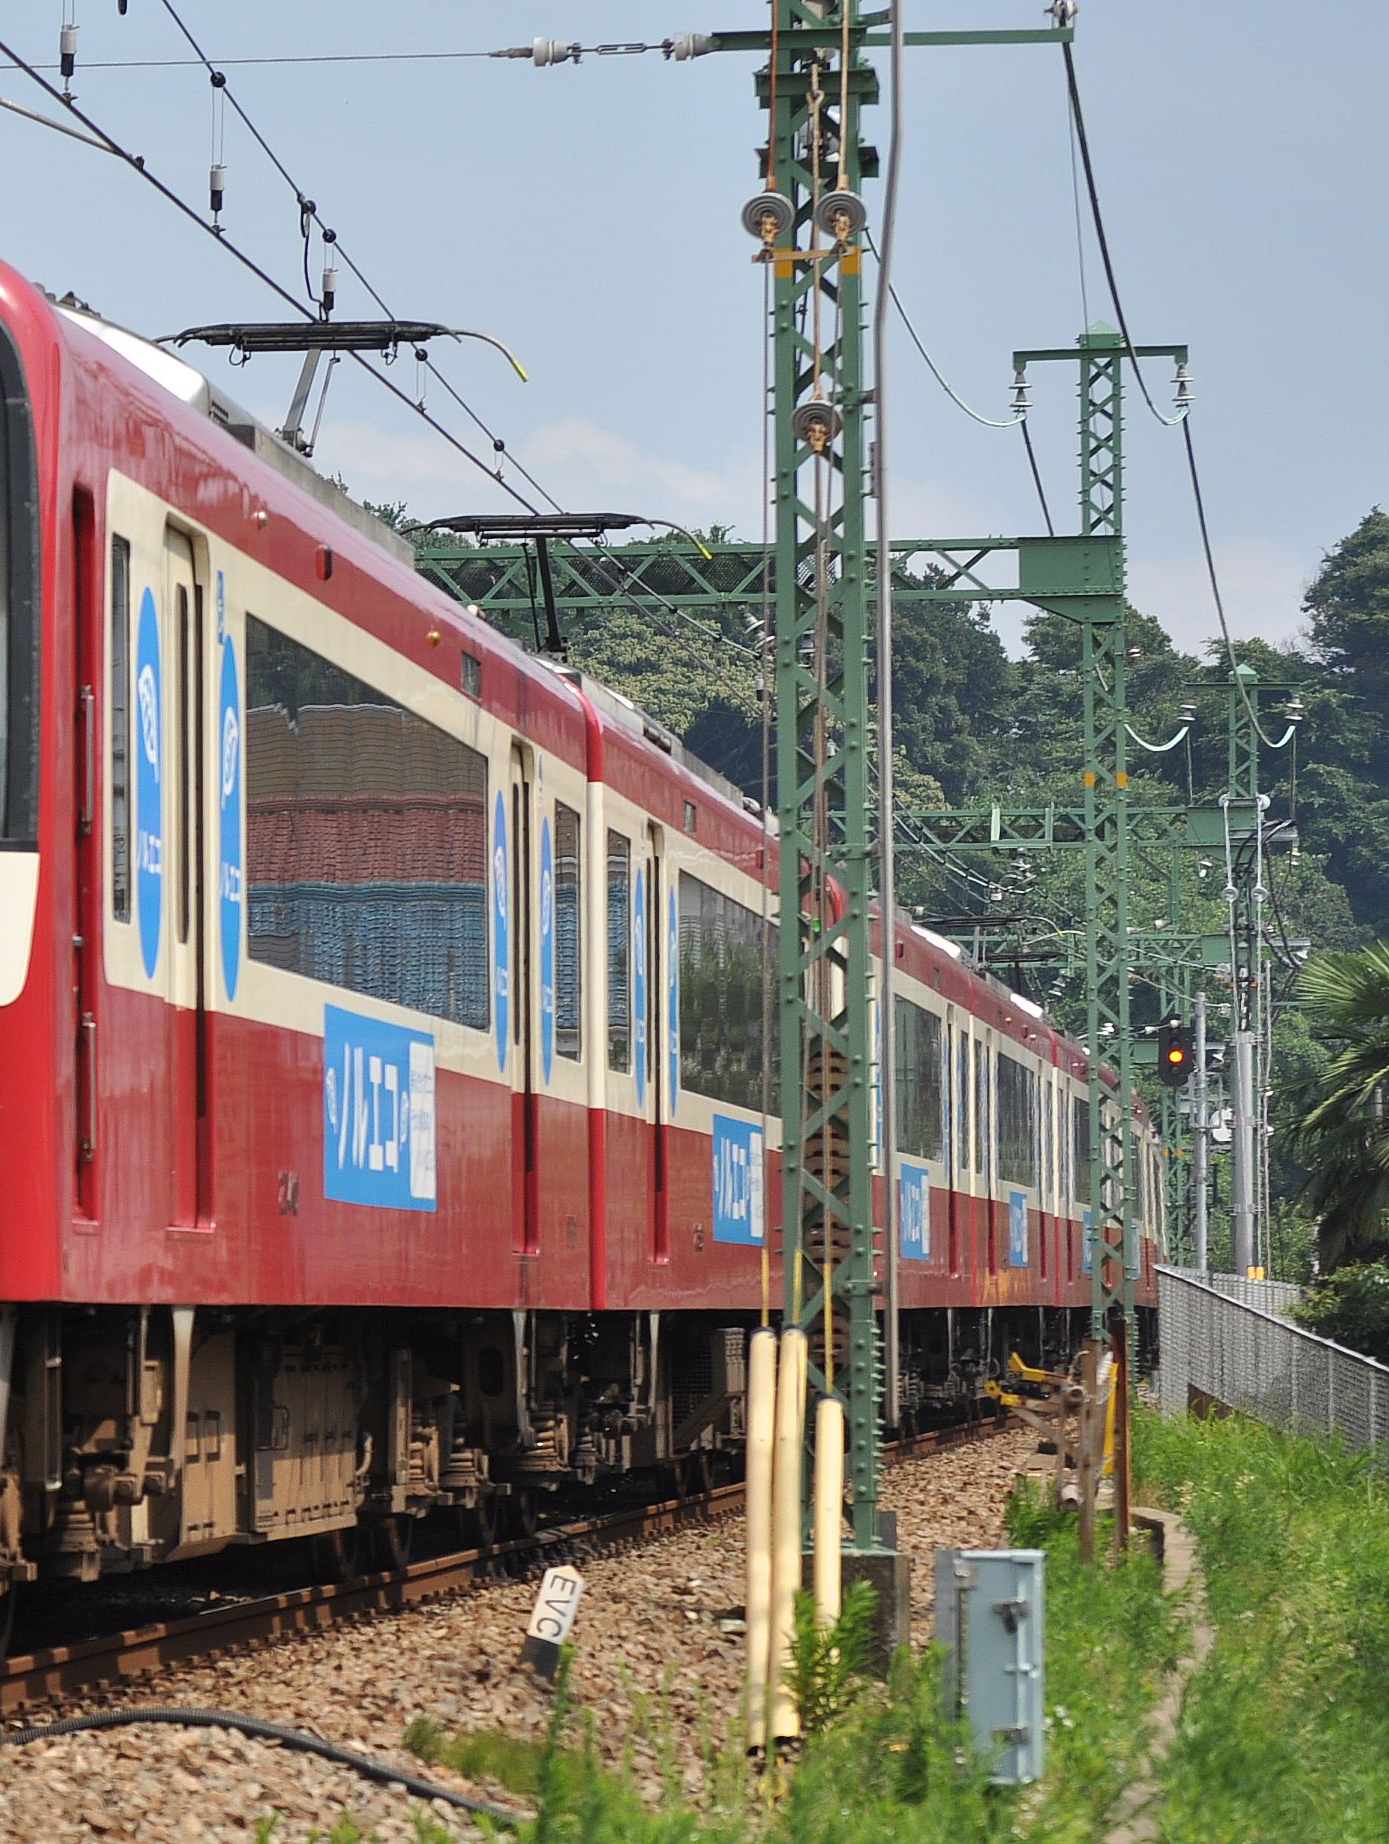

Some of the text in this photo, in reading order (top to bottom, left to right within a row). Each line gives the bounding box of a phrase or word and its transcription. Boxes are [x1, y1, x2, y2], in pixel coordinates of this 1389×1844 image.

[338, 1041, 399, 1174] ノルエコ
[535, 1574, 577, 1637] EVC
